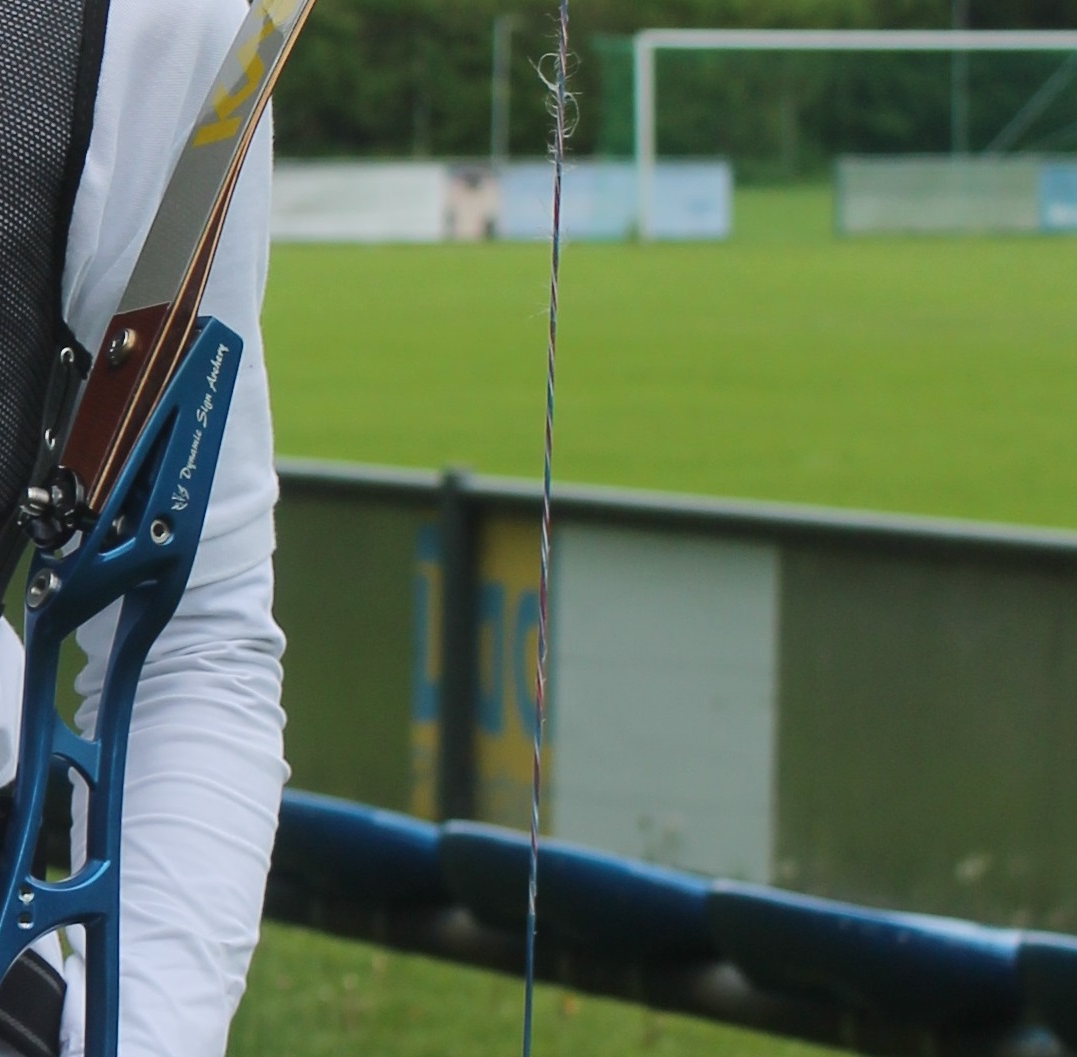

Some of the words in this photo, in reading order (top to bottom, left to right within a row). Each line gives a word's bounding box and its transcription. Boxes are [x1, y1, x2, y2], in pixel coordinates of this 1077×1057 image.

[179, 429, 203, 480] Dynamic
[196, 393, 213, 429] Sign
[206, 343, 230, 393] Archery
